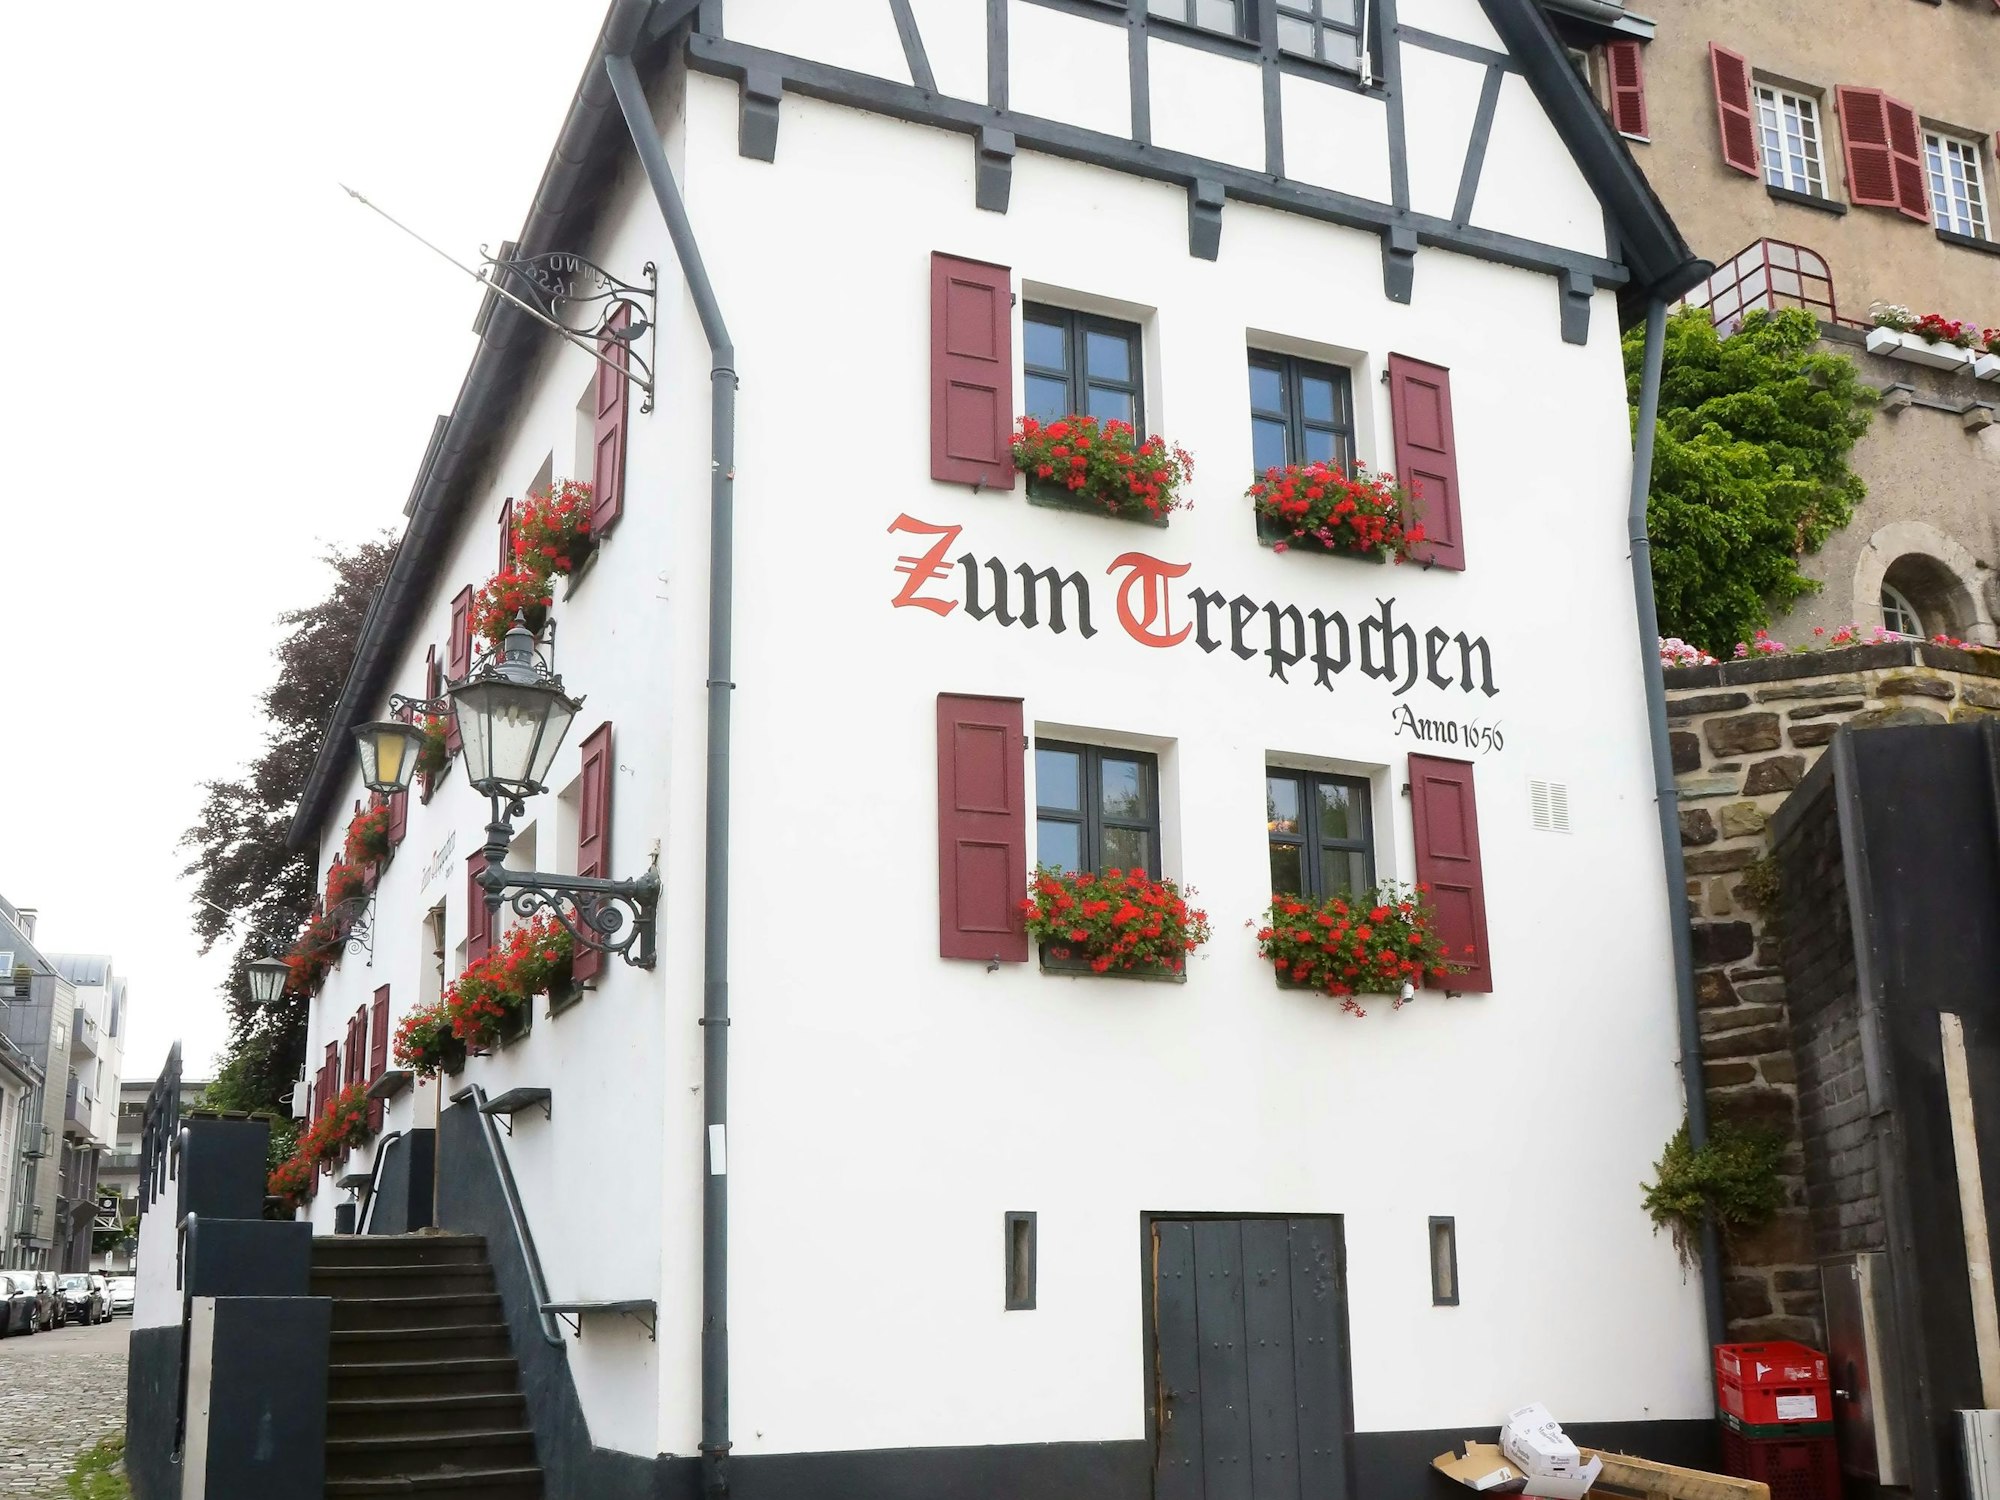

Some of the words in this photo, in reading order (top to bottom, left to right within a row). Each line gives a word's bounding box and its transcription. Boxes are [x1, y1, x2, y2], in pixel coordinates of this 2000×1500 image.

[887, 512, 1098, 640] Zum
[1106, 551, 1500, 698] Treppchen
[1392, 703, 1458, 744] Anno
[1460, 717, 1504, 755] 1656
